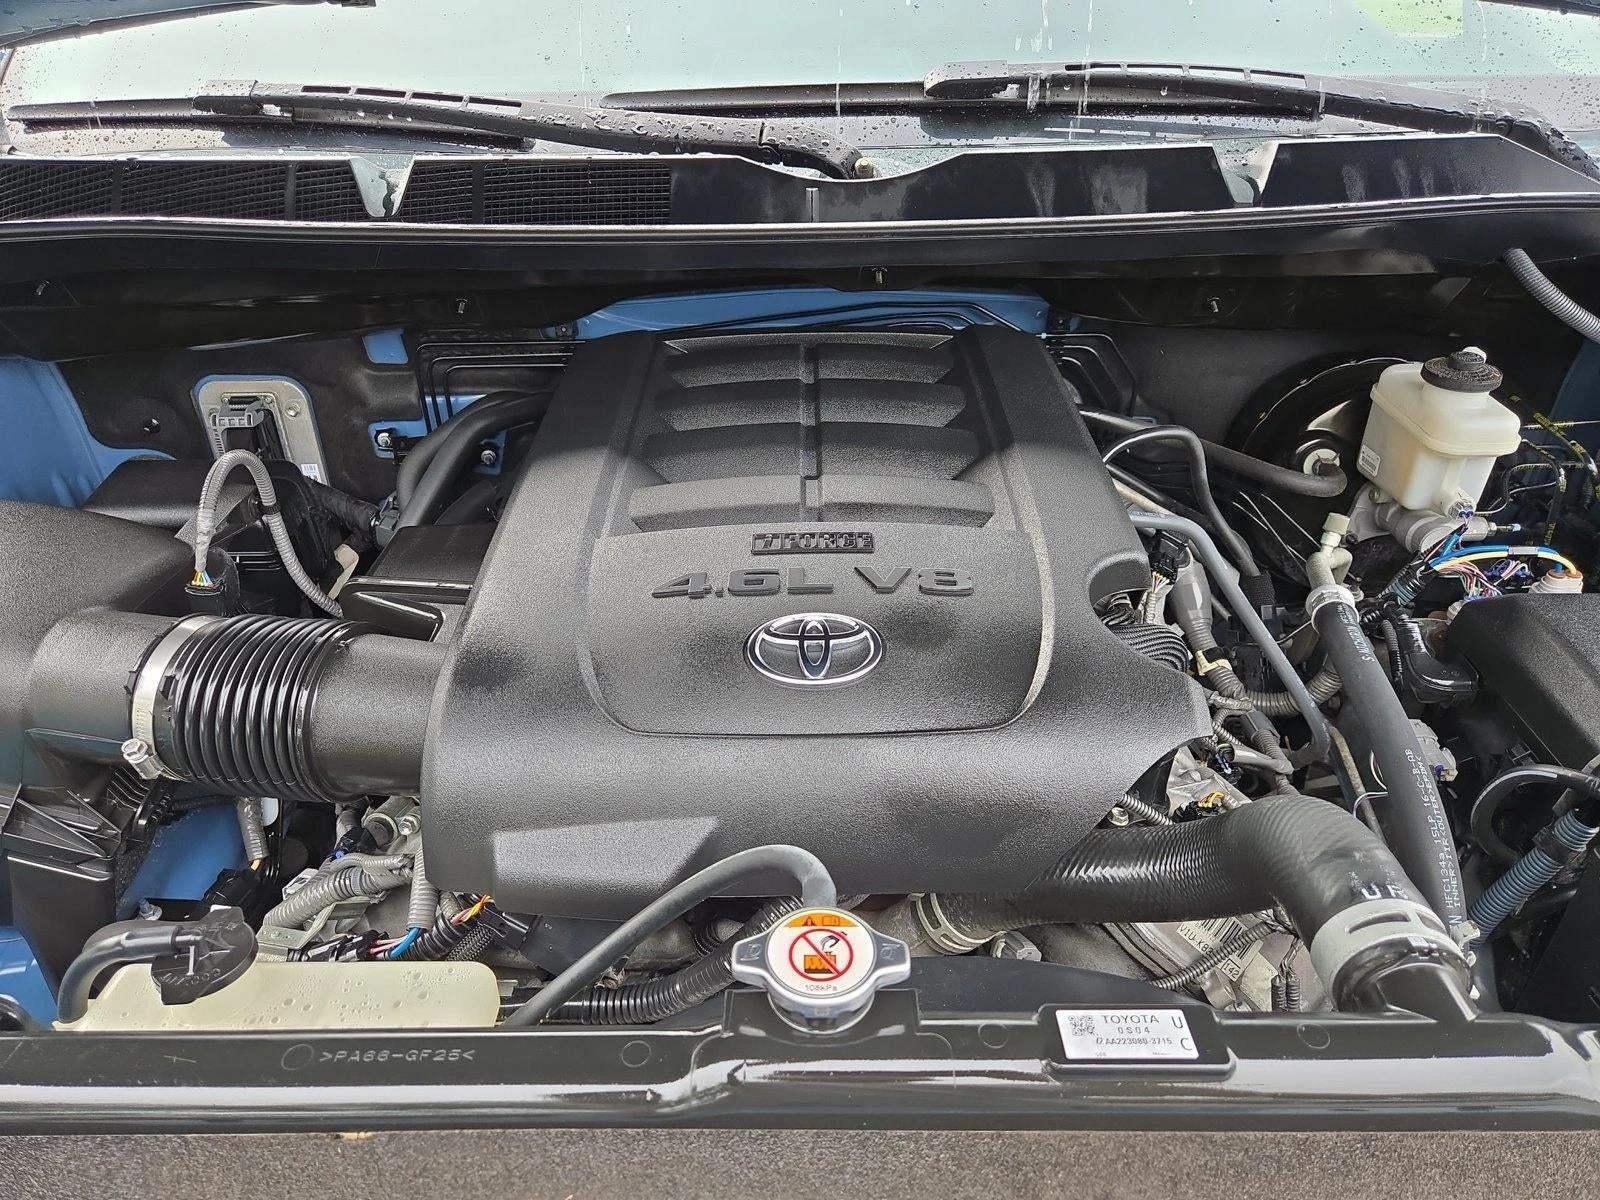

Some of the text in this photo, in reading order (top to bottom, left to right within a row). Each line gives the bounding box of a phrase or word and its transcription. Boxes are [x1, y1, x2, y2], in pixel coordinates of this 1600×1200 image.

[652, 566, 974, 599] 4.6L V8
[1102, 1014, 1160, 1024] TOYOTA
[1171, 1015, 1184, 1029] U
[1180, 1037, 1193, 1051] C
